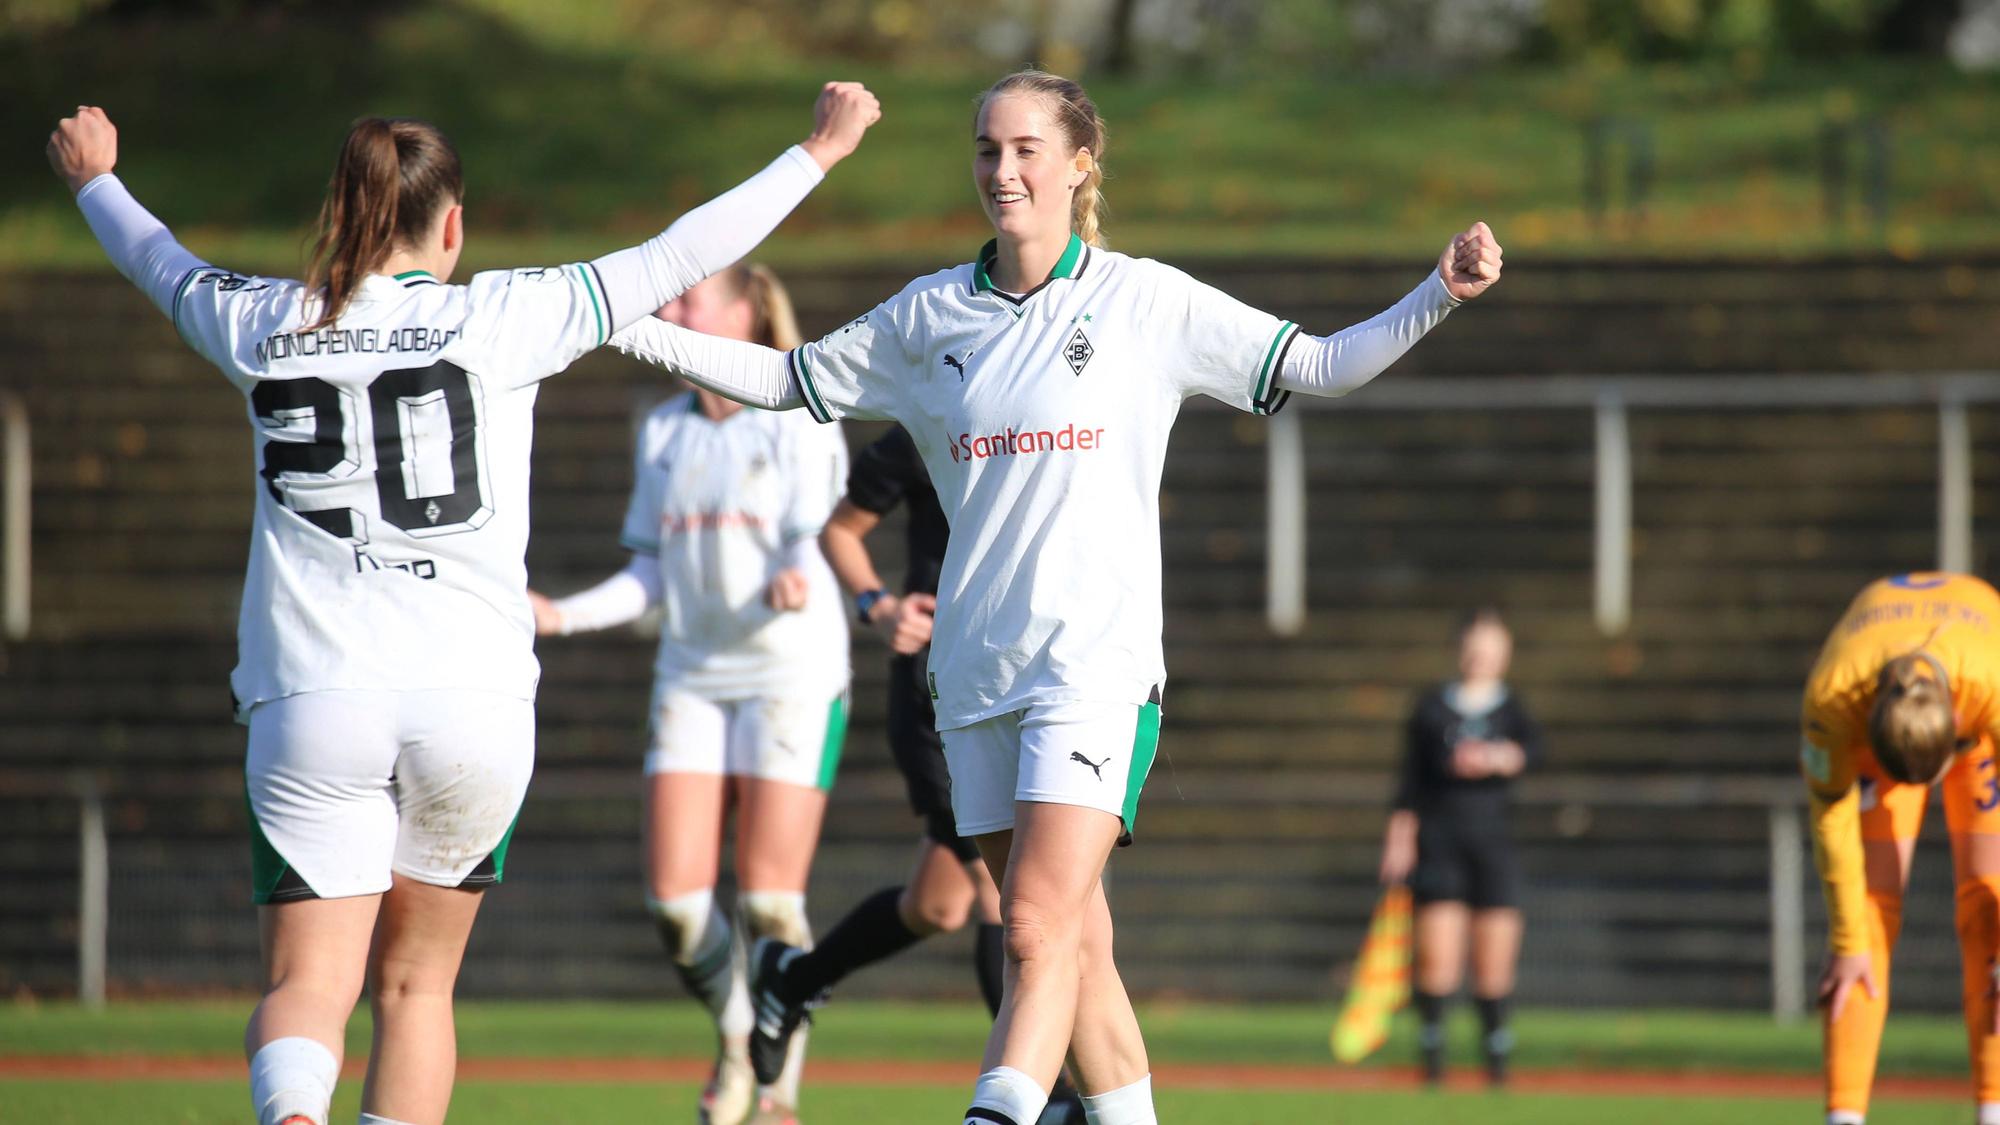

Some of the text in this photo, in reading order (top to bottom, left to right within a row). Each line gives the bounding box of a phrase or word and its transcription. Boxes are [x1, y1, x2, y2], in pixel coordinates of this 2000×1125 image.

[256, 328, 463, 365] MÖNCHENGLADBA
[252, 359, 495, 538] 20
[960, 423, 1105, 462] Santander
